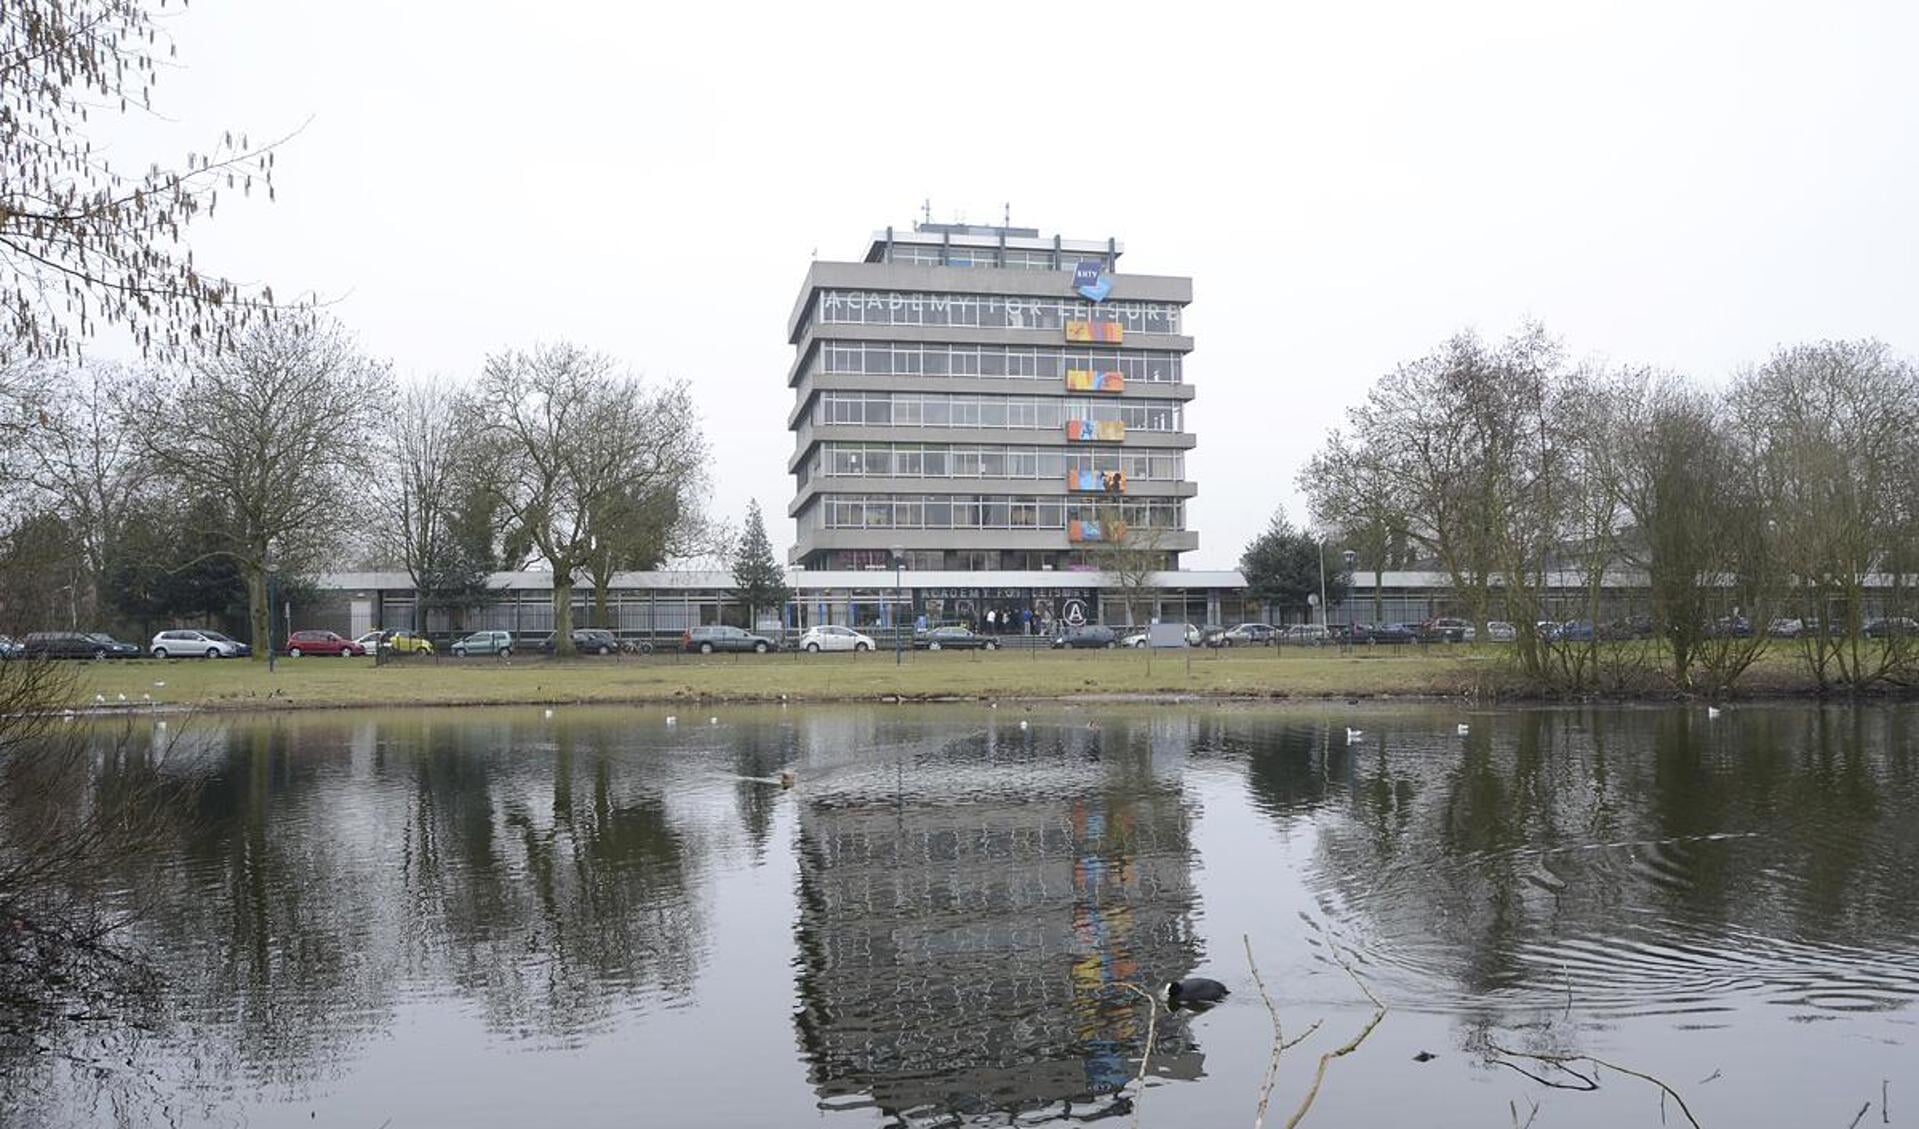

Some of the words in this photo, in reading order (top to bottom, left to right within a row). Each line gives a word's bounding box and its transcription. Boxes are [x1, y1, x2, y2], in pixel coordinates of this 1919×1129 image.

[825, 291, 970, 313] ACADEMY
[988, 297, 1042, 316] FOR
[1058, 301, 1179, 321] LEISURE
